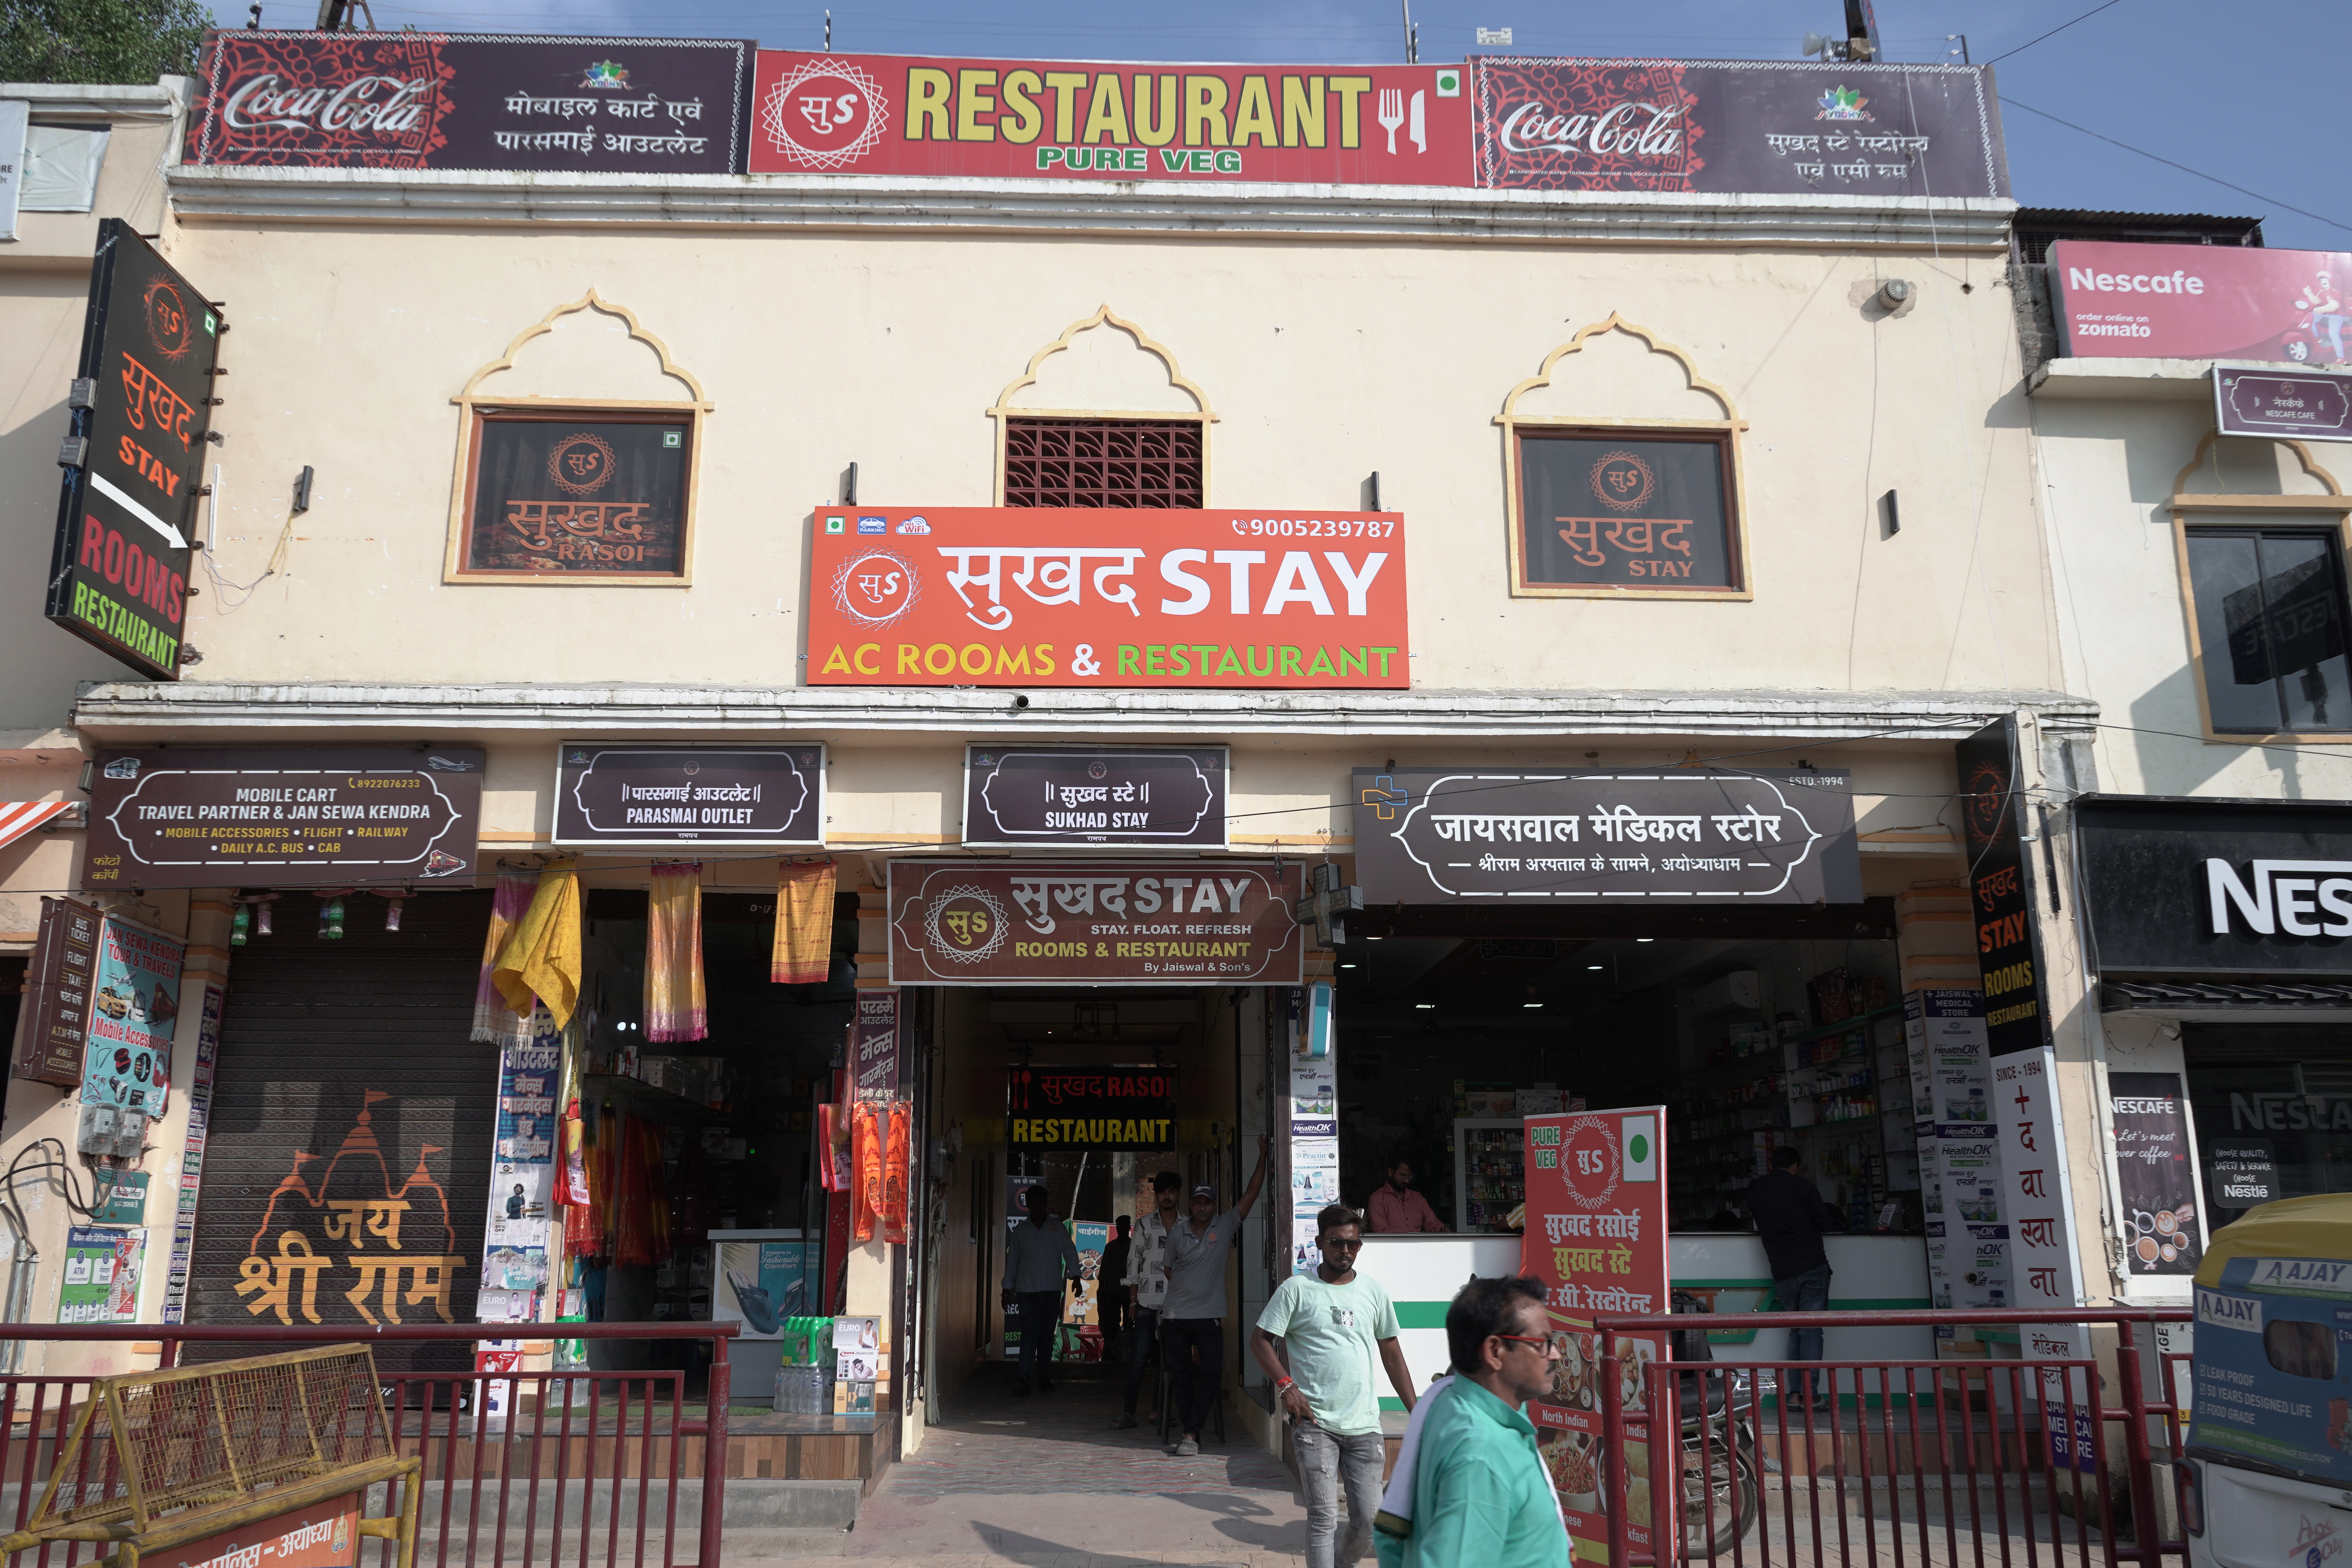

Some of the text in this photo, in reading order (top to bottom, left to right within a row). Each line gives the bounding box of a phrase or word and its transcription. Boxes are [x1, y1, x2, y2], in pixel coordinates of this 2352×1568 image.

[224, 74, 439, 131] Coca-Cola
[505, 91, 704, 126] मोबाइल कार्ट एवं
[906, 67, 1372, 148] RESTAURANT
[1501, 102, 1690, 155] Coca-Cola
[494, 125, 709, 156] पारसमाई आउटलेट
[1765, 129, 1850, 158] सुखद स्टे
[1037, 147, 1241, 174] PURE VEG
[2069, 267, 2204, 294] Nescafe
[2076, 314, 2103, 322] order
[2105, 314, 2134, 323] online
[2078, 322, 2151, 338] zomato
[123, 350, 196, 454] सुखद
[2265, 410, 2296, 419] NESCAFE
[118, 434, 181, 499] STAY
[506, 500, 650, 551] सुखद
[1251, 518, 1395, 539] 9005239787
[1555, 516, 1693, 567] सुखद
[557, 544, 645, 562] RASOI
[80, 513, 185, 625] ROOMS
[1628, 559, 1695, 577] STAY
[936, 546, 1389, 631] सुखद STAY
[73, 579, 178, 671] RESTAURANT
[821, 642, 1399, 677] AC ROOMS & RESTAURANT
[357, 778, 420, 789] 8922076233
[1789, 776, 1843, 786] ESTD.-1994
[236, 788, 338, 803] MOBILE CART
[632, 782, 751, 803] पारसमाई आउटलेट
[1060, 781, 1136, 808] सुखद स्टे
[138, 804, 430, 820] TRAVEL PARTNER JAN SEWA KENDRA
[627, 808, 754, 824] PARASMAI OUTLET
[1045, 811, 1149, 829] SUKHAD STAY
[165, 827, 408, 838] MOBILE ACCESSORIES FLIGHT RAILWAY
[1430, 804, 1781, 842] जायसवाल मेडिकल स्टोर
[221, 842, 341, 853] DAILY A.C. BUS CAB
[93, 855, 122, 867] फोटो
[1479, 853, 1741, 872] श्रीराम अस्पताल के अयोध्याधाम
[92, 867, 120, 880] कॉपी
[1977, 866, 2017, 912] सुखद
[1010, 877, 1252, 935] सुखद STAY
[76, 918, 88, 931] BUS
[1090, 924, 1252, 935] STAY. FLOAT. REFRESH
[1979, 910, 2026, 953] STAY
[71, 927, 90, 943] TICKET
[106, 925, 181, 965] JAN SEWA KENDRA
[1014, 942, 1251, 958] ROOMS & RESTAURANT
[1498, 941, 1554, 955] CHEMIST
[67, 951, 87, 967] FLIGHT
[108, 942, 176, 979] TOUR TRAVELS
[1144, 962, 1251, 973] By Jaiswal Son's
[69, 973, 81, 987] TAXI
[1984, 960, 2033, 998] ROOMS
[1935, 990, 1972, 998] JAISWAL
[1936, 999, 1973, 1007] MEDICAL
[860, 995, 895, 1014] परस्मै
[1941, 1009, 1969, 1017] STORE
[1987, 1000, 2037, 1028] RESTAURANT
[860, 1014, 895, 1025] आउटलेट
[93, 1017, 169, 1054] Mobile Accessories
[860, 1029, 893, 1062] मेन्स
[1934, 1044, 1980, 1054] HealthOK
[859, 1056, 895, 1088] गारमेंट्स
[1996, 1059, 2042, 1083] SINCE 1994
[515, 1074, 544, 1093] मेन्स
[858, 1088, 873, 1098] डेली
[1040, 1075, 1105, 1105] सुखद
[502, 1094, 554, 1118] गारमेंट्स
[1013, 1119, 1171, 1143] RESTAURANT
[1532, 1126, 1560, 1146] PURE
[1945, 1126, 1987, 1135] HealthOK
[2149, 1131, 2176, 1142] meet
[1535, 1149, 1557, 1168] VEG
[1942, 1144, 1993, 1156] HealthOK
[2139, 1146, 2171, 1165] coffee
[2216, 1149, 2238, 1158] CHOOSE
[2215, 1161, 2272, 1171] SAFETY SERVICE
[2233, 1174, 2256, 1183] CHOOSE
[323, 1200, 412, 1250] जय
[1077, 1227, 1106, 1236] चाईनीज
[1544, 1208, 1641, 1244] सुखद रसोई
[760, 1254, 800, 1264] Fashionable
[1552, 1242, 1632, 1280] सुखद स्टे
[73, 1267, 85, 1276] ATM
[234, 1230, 334, 1326] श्री
[345, 1256, 467, 1325] राम
[2285, 1262, 2348, 1282] AJAY
[483, 1296, 506, 1305] EURO
[2214, 1296, 2255, 1321] AJAY
[838, 1324, 860, 1332] EURO
[2032, 1333, 2071, 1357] मेडिकल
[2207, 1366, 2255, 1387] LEAK PROOF
[2207, 1385, 2313, 1418] 50 YEARS DESIGNED LIFE
[1542, 1408, 1588, 1428] North Indian
[2207, 1403, 2255, 1425] FOOD GRADE
[2226, 1433, 2298, 1458] PLUMBING AND DRAINAGE
[278, 1518, 334, 1558] अयोध्या
